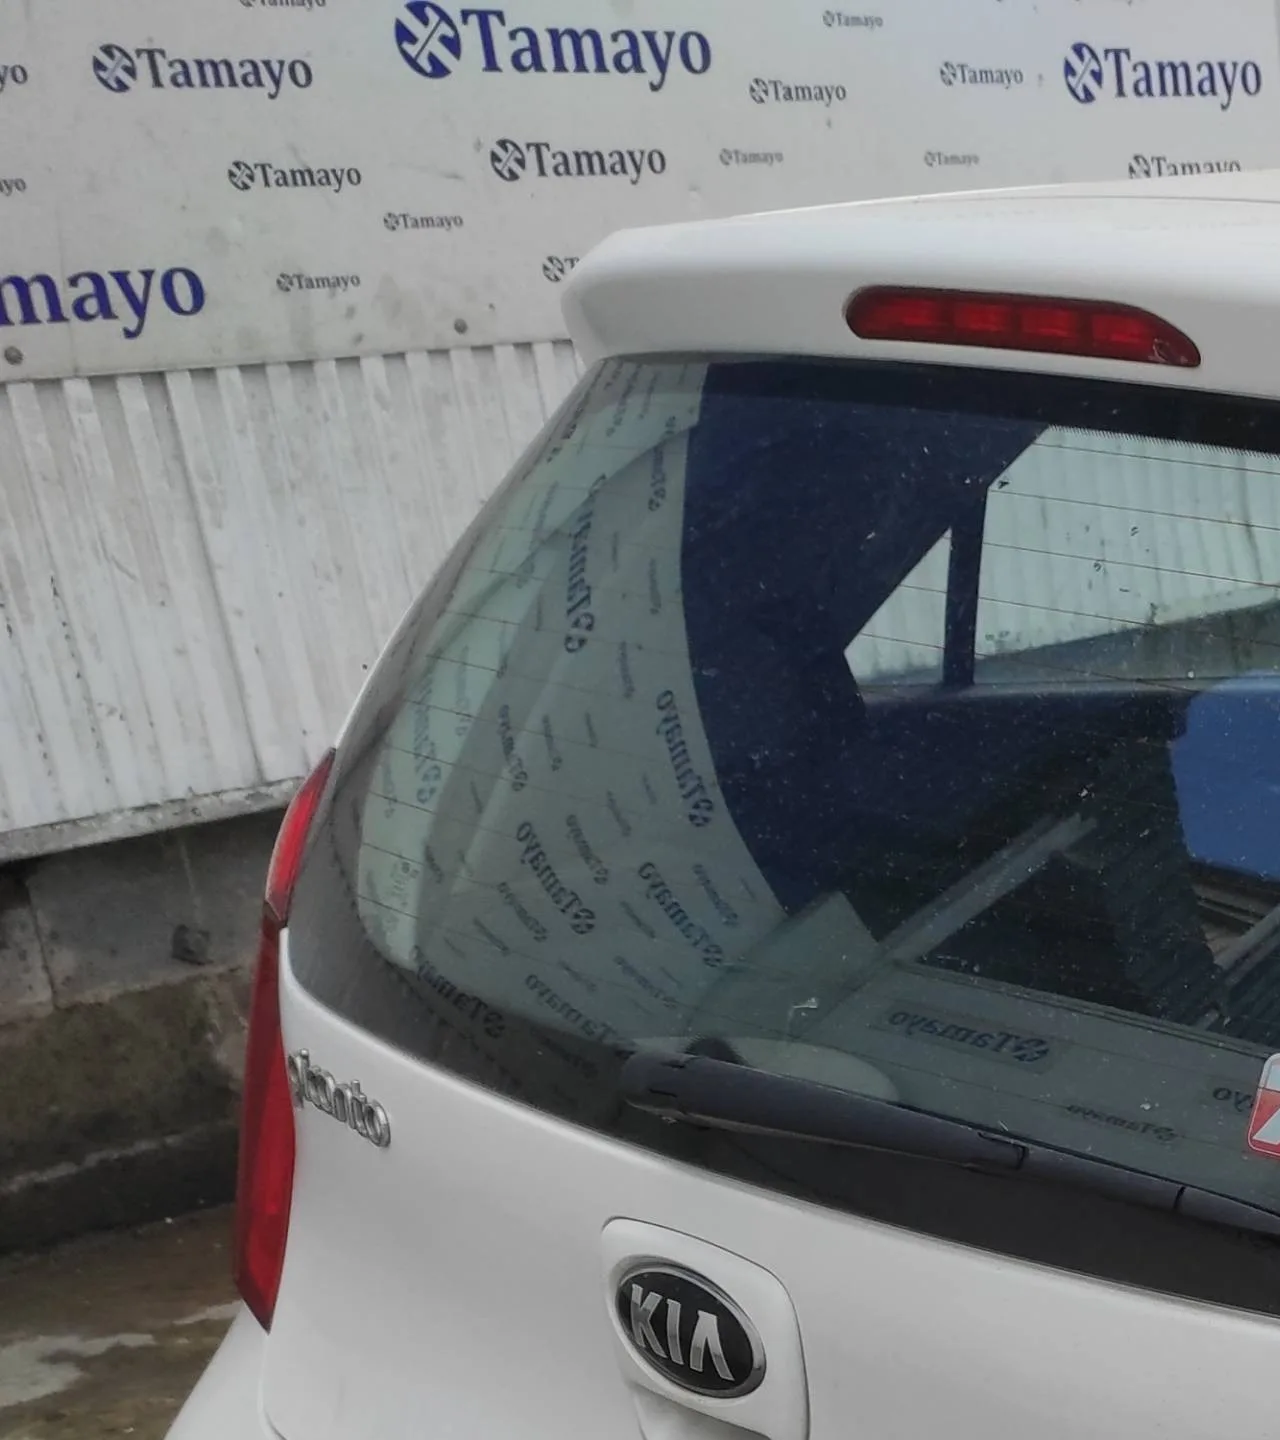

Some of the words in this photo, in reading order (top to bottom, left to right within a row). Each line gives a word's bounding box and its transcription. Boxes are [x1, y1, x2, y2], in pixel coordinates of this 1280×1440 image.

[836, 12, 883, 28] Tamayo
[461, 9, 711, 92] Tamayo
[135, 48, 313, 99] Tamayo
[957, 64, 1023, 89] Tamayo
[1104, 48, 1261, 110] Tamayo
[769, 80, 846, 107] Tamayo
[526, 142, 665, 185] Tamayo
[733, 150, 783, 166] Tamayo
[254, 163, 361, 192] Tamayo
[399, 213, 463, 231] Tamayo
[295, 273, 361, 290] Tamayo
[632, 1283, 735, 1382] KIA
